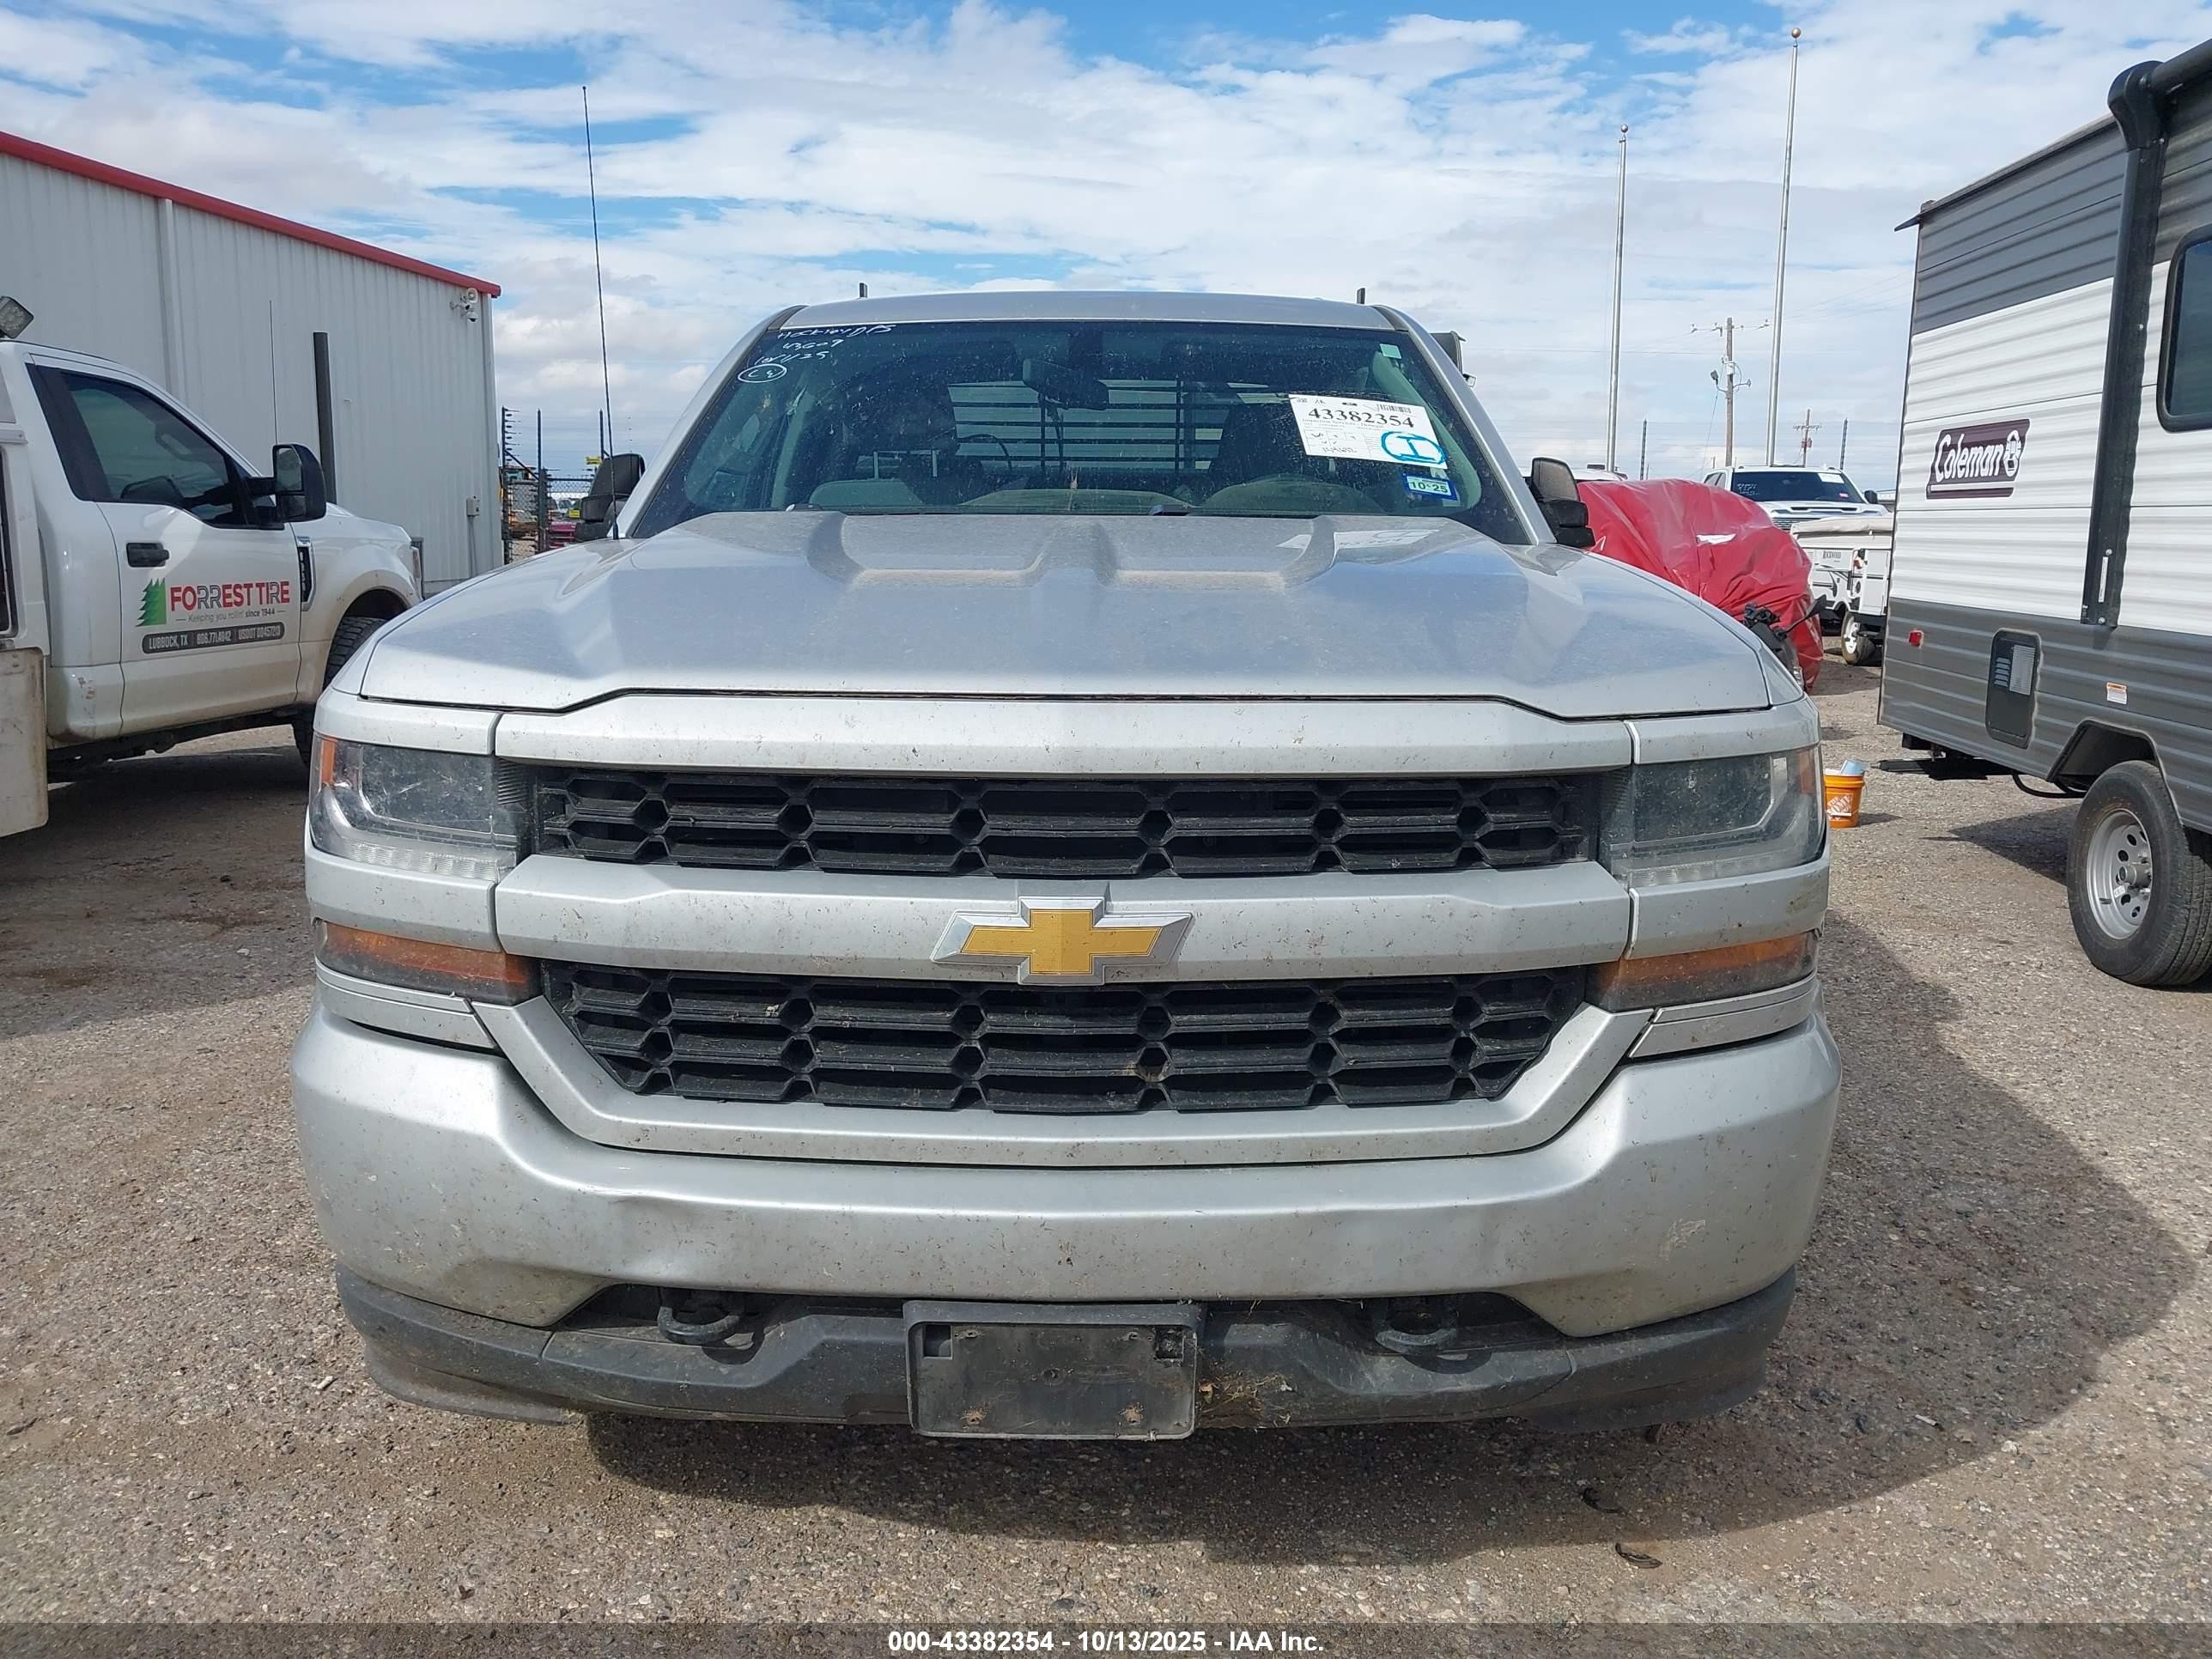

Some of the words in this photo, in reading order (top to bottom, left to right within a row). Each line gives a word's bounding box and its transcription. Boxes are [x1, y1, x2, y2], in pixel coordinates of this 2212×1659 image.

[1308, 407, 1415, 428] 43382354
[1935, 433, 2004, 483] Coleman
[170, 582, 253, 611] FORREST
[255, 580, 290, 605] TIRE
[188, 613, 216, 623] Keeping
[216, 613, 228, 622] you
[245, 610, 260, 618] since
[261, 608, 275, 617] 1944
[180, 634, 188, 646] TX
